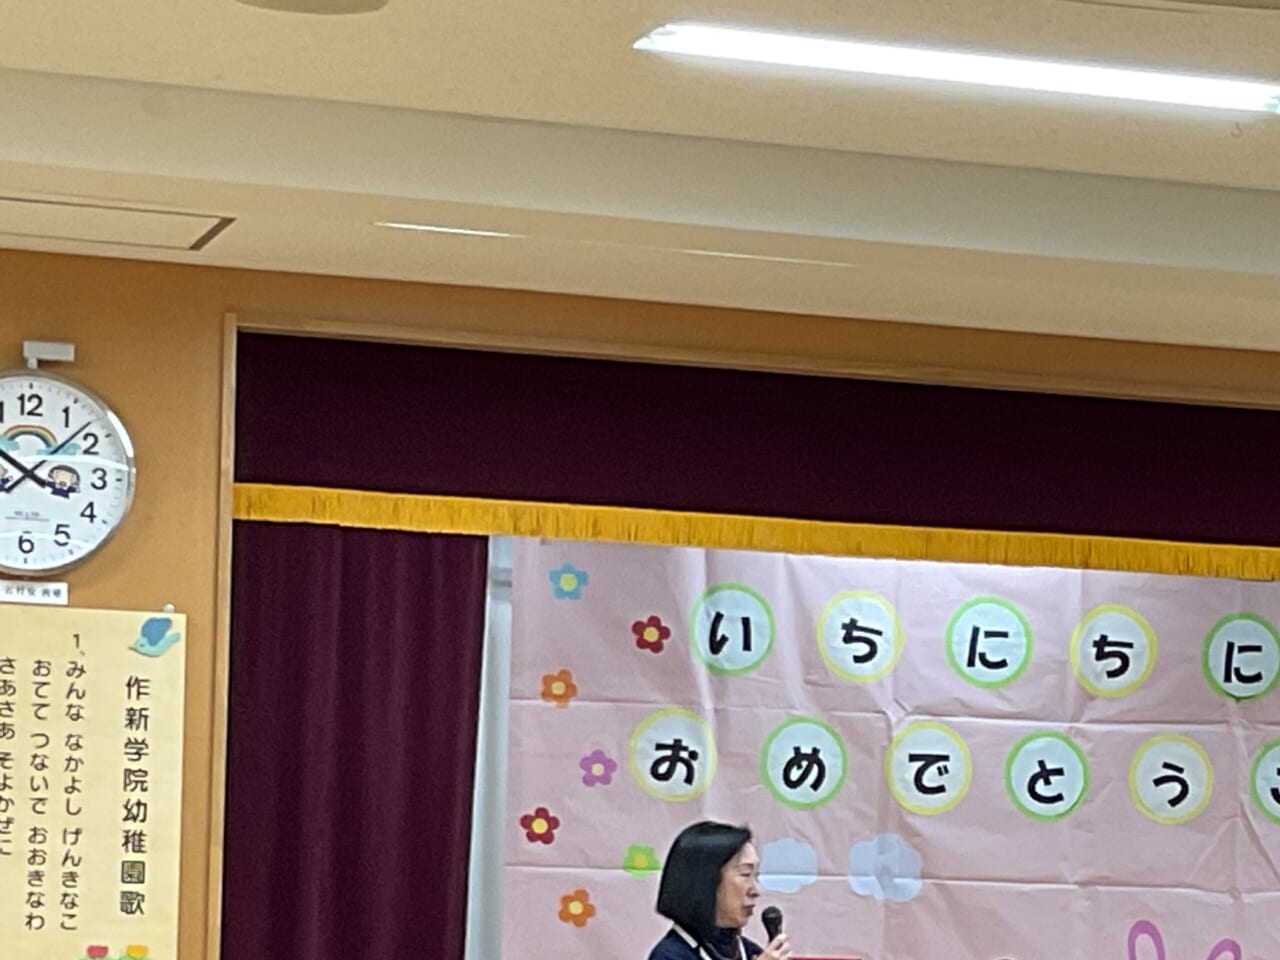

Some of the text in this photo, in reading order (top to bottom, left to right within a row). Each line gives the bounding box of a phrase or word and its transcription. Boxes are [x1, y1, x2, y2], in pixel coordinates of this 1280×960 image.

[16, 393, 43, 417] 12
[62, 406, 70, 428] 1
[82, 433, 99, 455] 2
[91, 468, 107, 490] 3
[80, 502, 96, 523] 4
[18, 534, 34, 554] 6
[54, 524, 71, 546] 5
[63, 732, 85, 816] なかよし
[25, 659, 51, 931] おてて つないで おおきなわ
[119, 675, 150, 915] 作新学院幼稚園歌
[60, 827, 83, 931] げんきなこ
